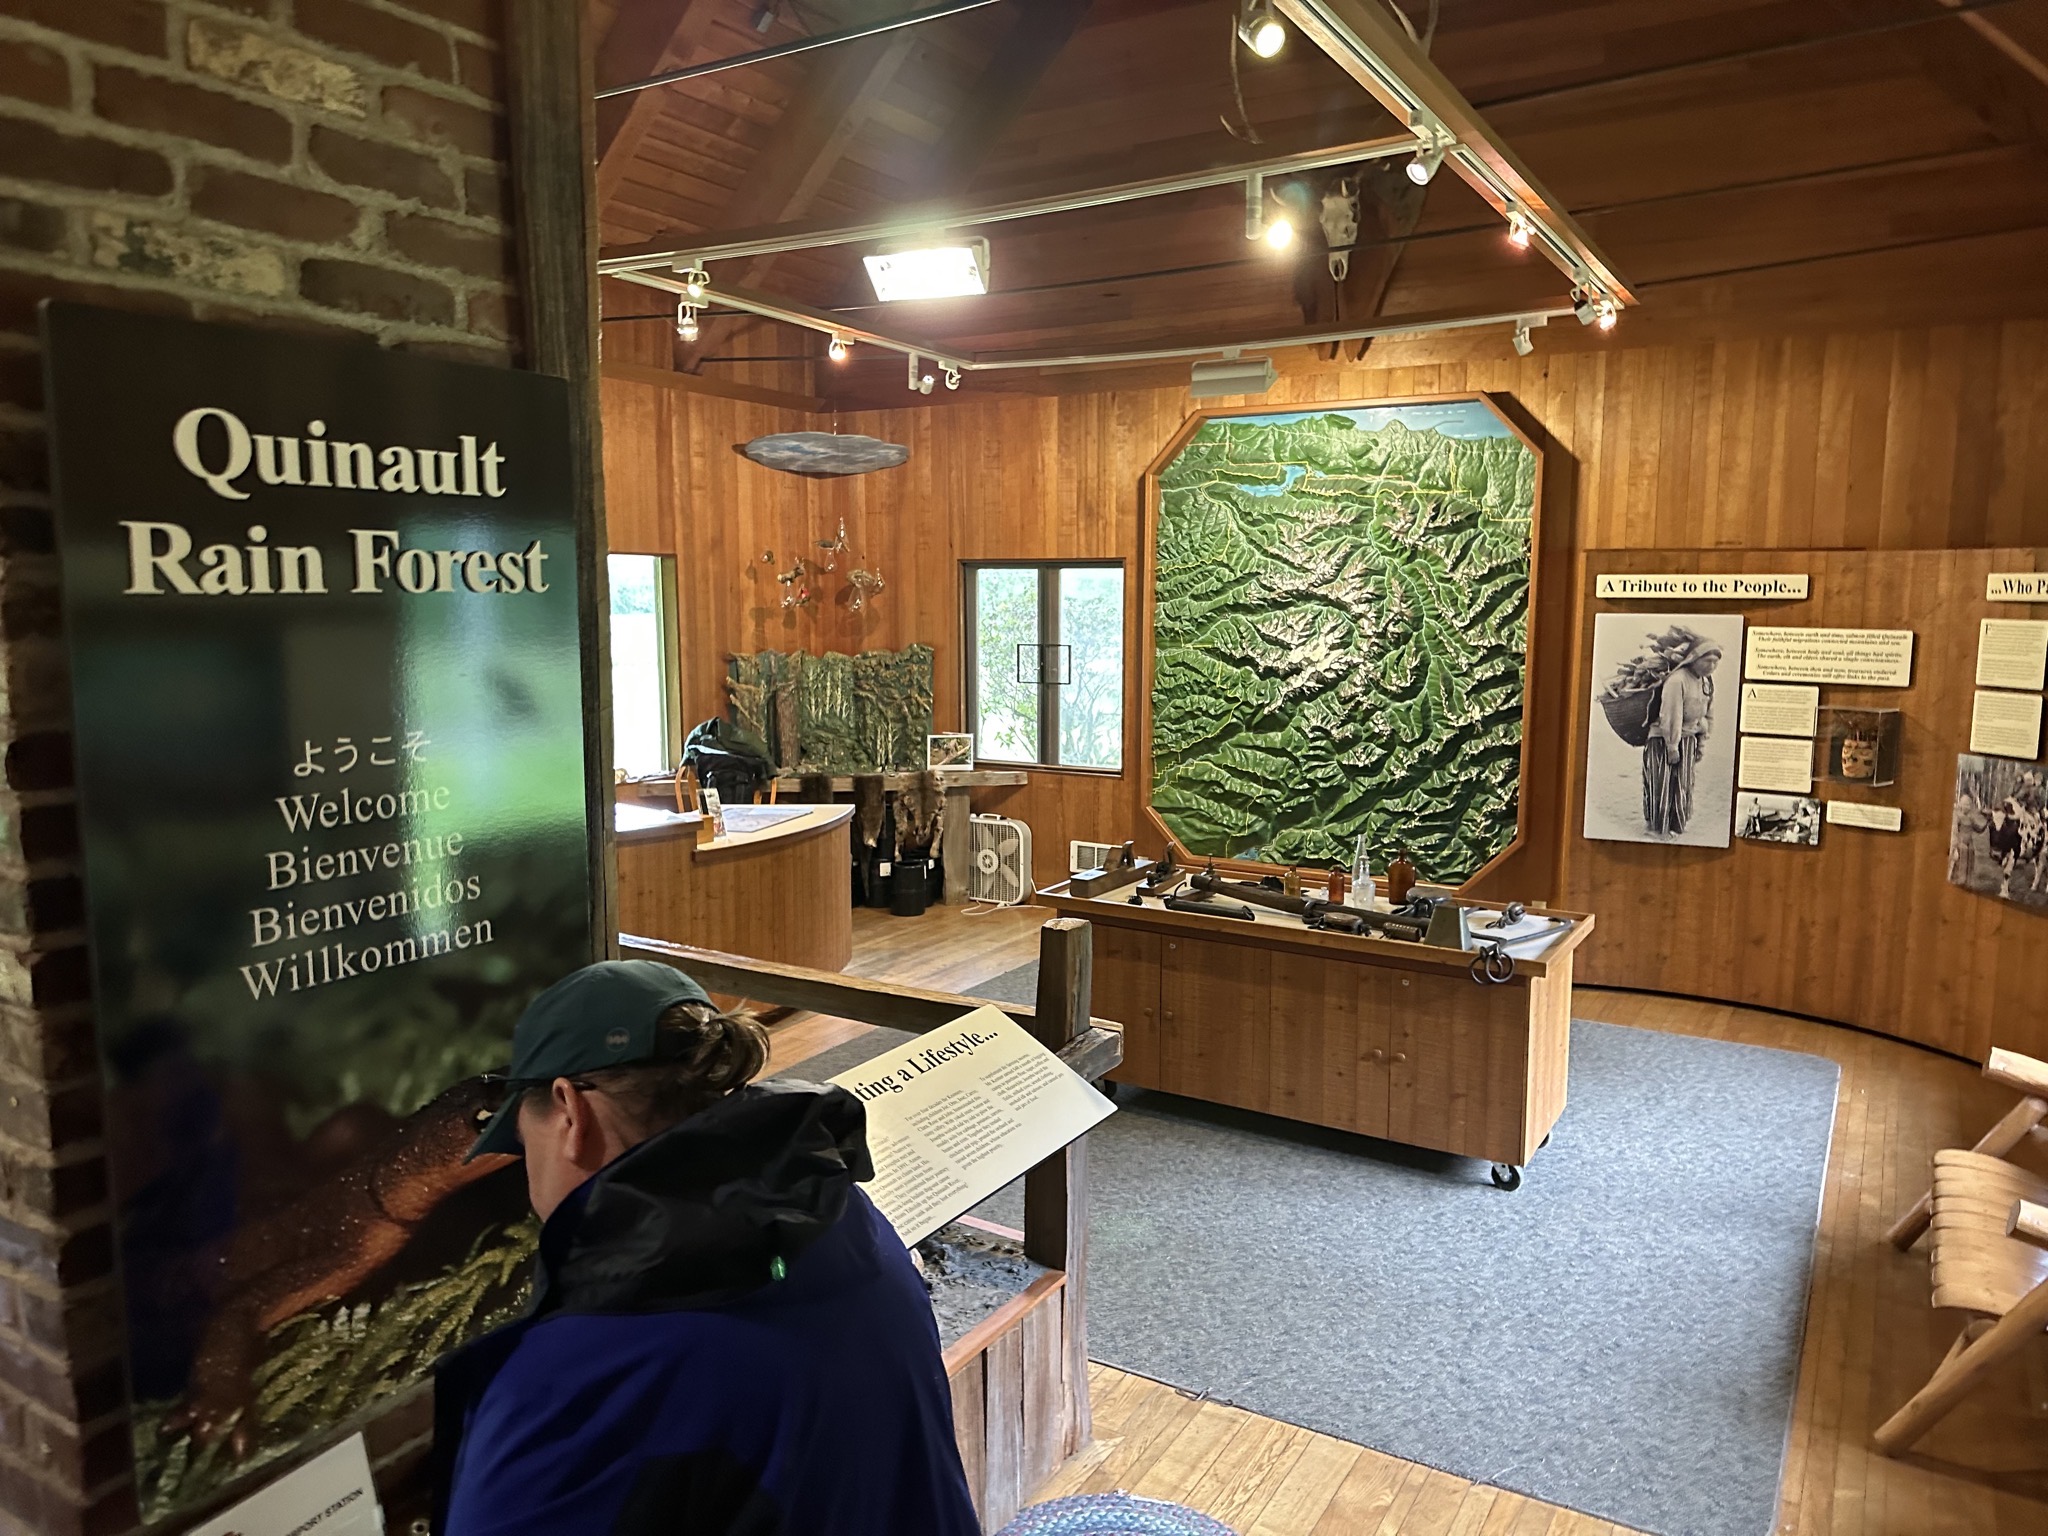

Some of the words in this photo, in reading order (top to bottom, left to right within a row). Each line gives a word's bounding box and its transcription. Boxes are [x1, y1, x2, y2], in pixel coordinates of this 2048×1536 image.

[172, 406, 508, 500] Quinault
[118, 520, 328, 596] Rain
[347, 527, 550, 595] Forest
[1603, 580, 1615, 593] A
[1619, 579, 1678, 593] Tribute
[1683, 581, 1697, 593] to
[1703, 579, 1727, 593] the
[1733, 580, 1801, 597] People...
[293, 730, 431, 777] ようこそ
[275, 785, 450, 834] Welcome
[265, 831, 464, 891] Bienvenue
[249, 874, 481, 948] Bienvenidos
[239, 918, 495, 1001] Willkommen
[897, 1068, 914, 1082] a
[905, 1032, 998, 1075] Lifestyle...
[854, 1076, 904, 1101] ting
